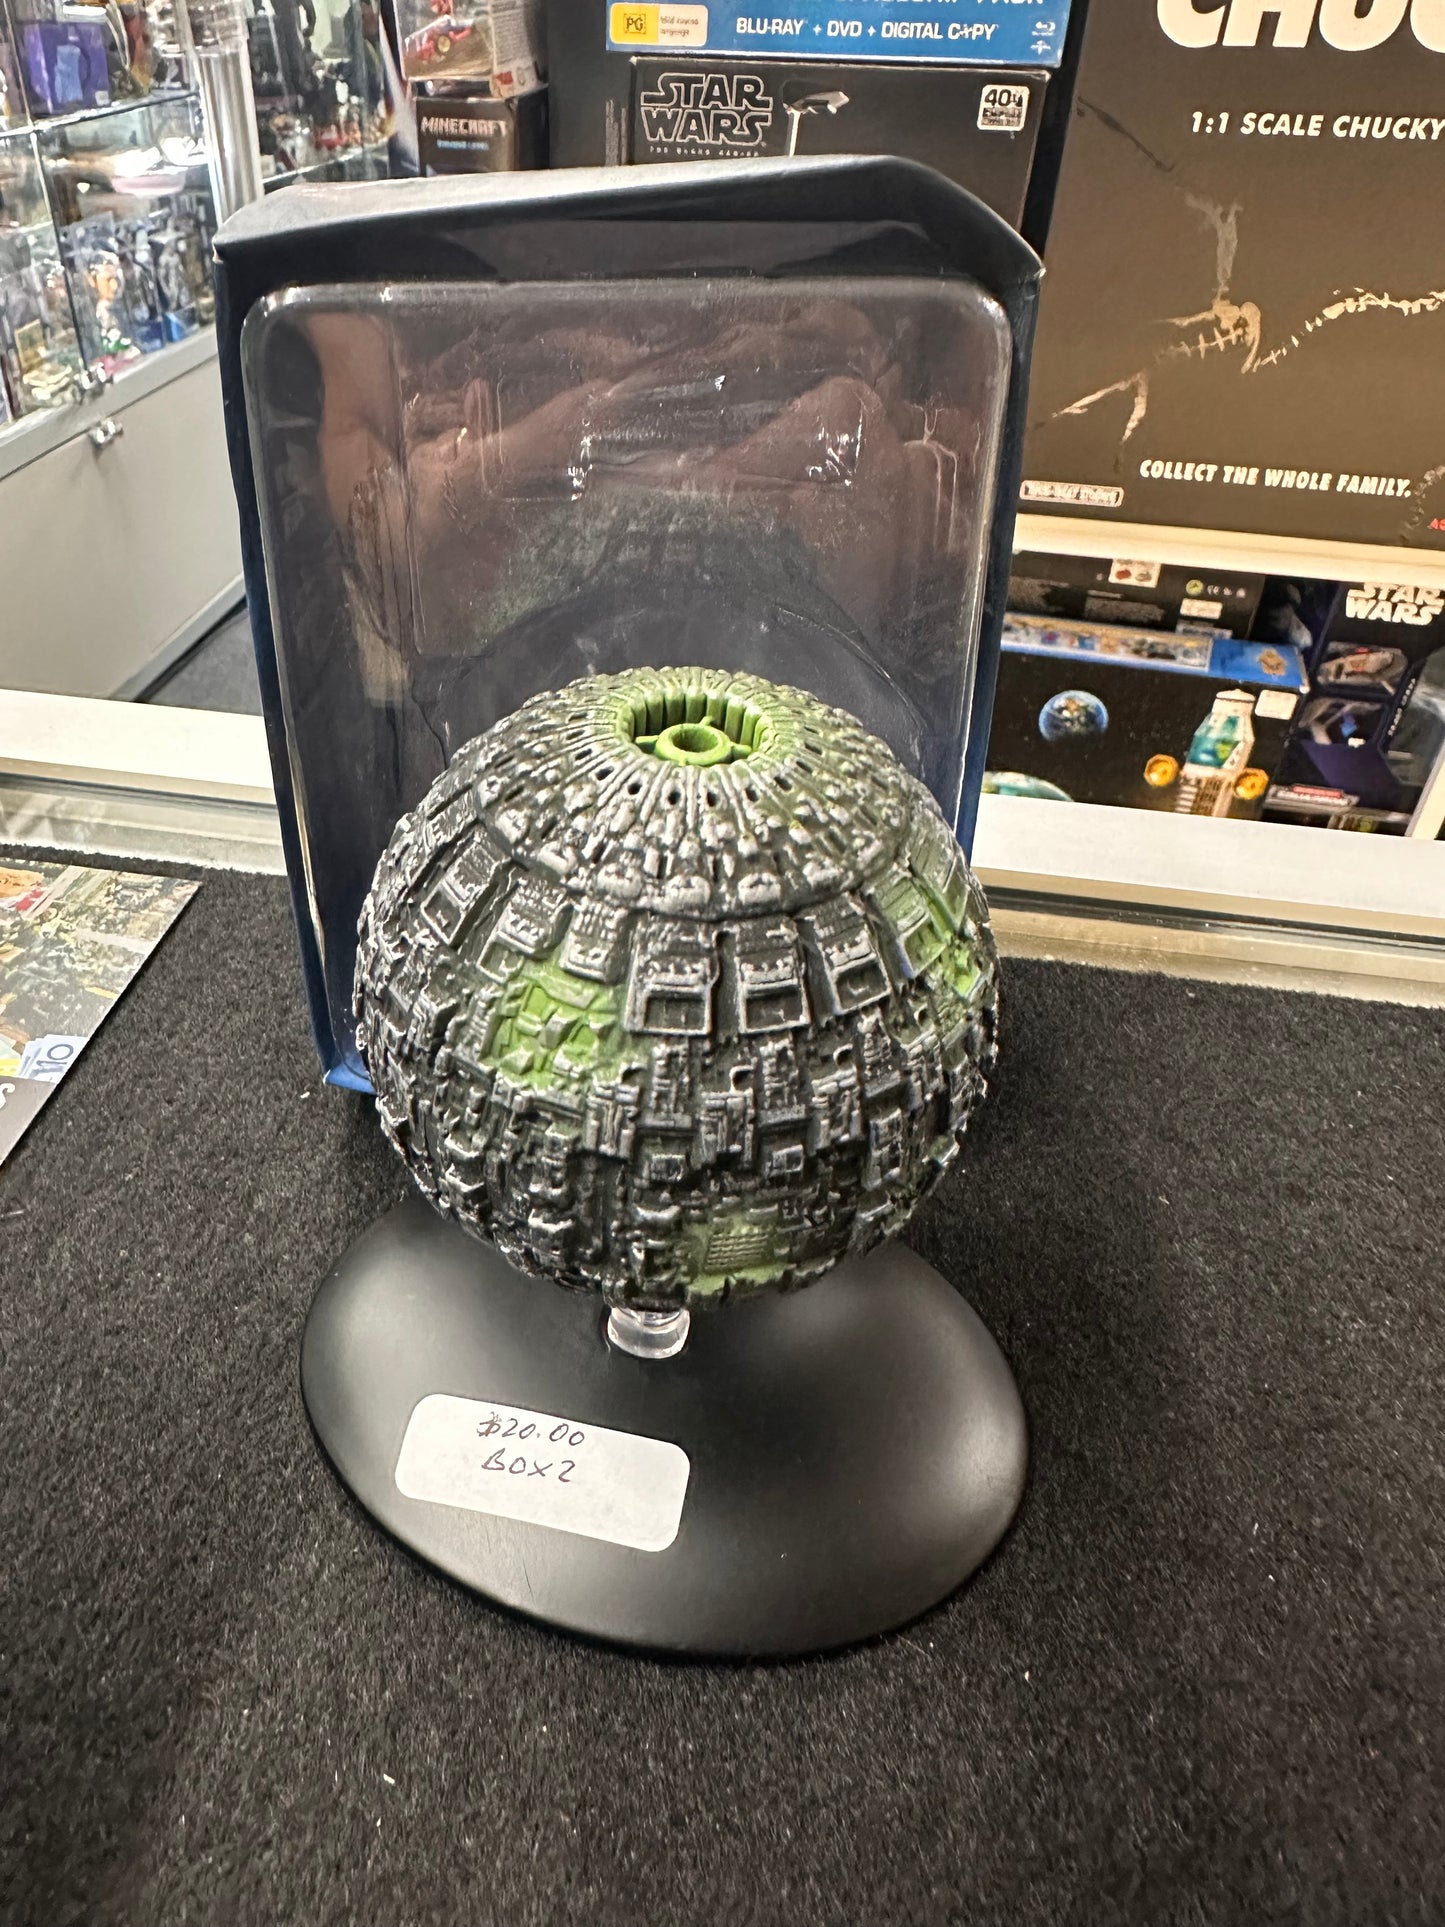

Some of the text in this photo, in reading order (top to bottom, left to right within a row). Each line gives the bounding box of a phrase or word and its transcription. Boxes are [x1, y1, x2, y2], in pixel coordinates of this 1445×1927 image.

[626, 16, 644, 31] PG
[736, 17, 803, 35] BLU-RAY
[827, 20, 862, 37] DVD
[881, 22, 943, 39] DIGITAL
[1157, 0, 1445, 53] CHU
[640, 72, 773, 111] STAR
[420, 116, 508, 137] MINECRAFT
[640, 106, 773, 147] WARS
[1192, 111, 1445, 141] 1:1 SCALE CHUCKY
[1139, 459, 1411, 498] COLLECT THE WHOLE FAMILY.
[1347, 583, 1445, 606] STAR
[1345, 596, 1443, 626] WARS
[476, 1411, 585, 1446] $20.00
